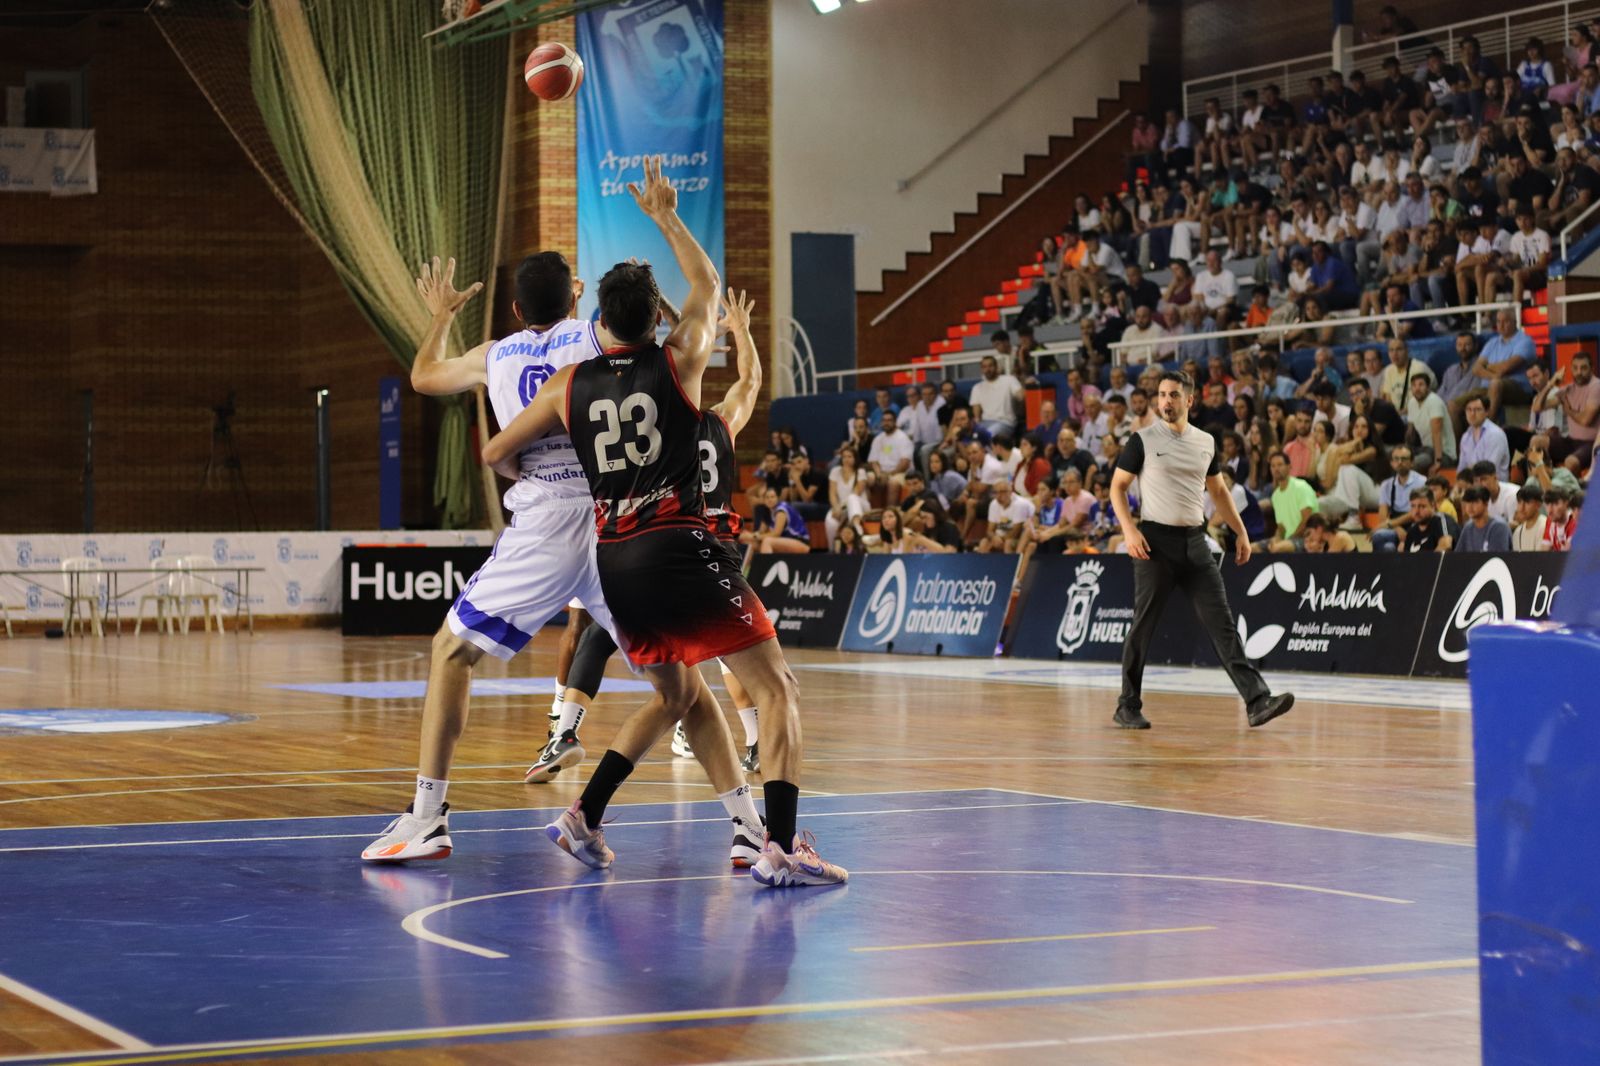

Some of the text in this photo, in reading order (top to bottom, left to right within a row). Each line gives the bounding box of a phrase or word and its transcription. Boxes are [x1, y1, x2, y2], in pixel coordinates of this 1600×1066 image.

[598, 150, 708, 184] Apoamos
[496, 331, 583, 361] DOMINUEZ
[589, 392, 662, 473] 23
[913, 572, 996, 605] baloncesto
[1298, 573, 1387, 613] Andalucía
[1291, 621, 1373, 638] Región Europea del
[1287, 639, 1330, 652] DEPORTE
[419, 780, 433, 790] 23
